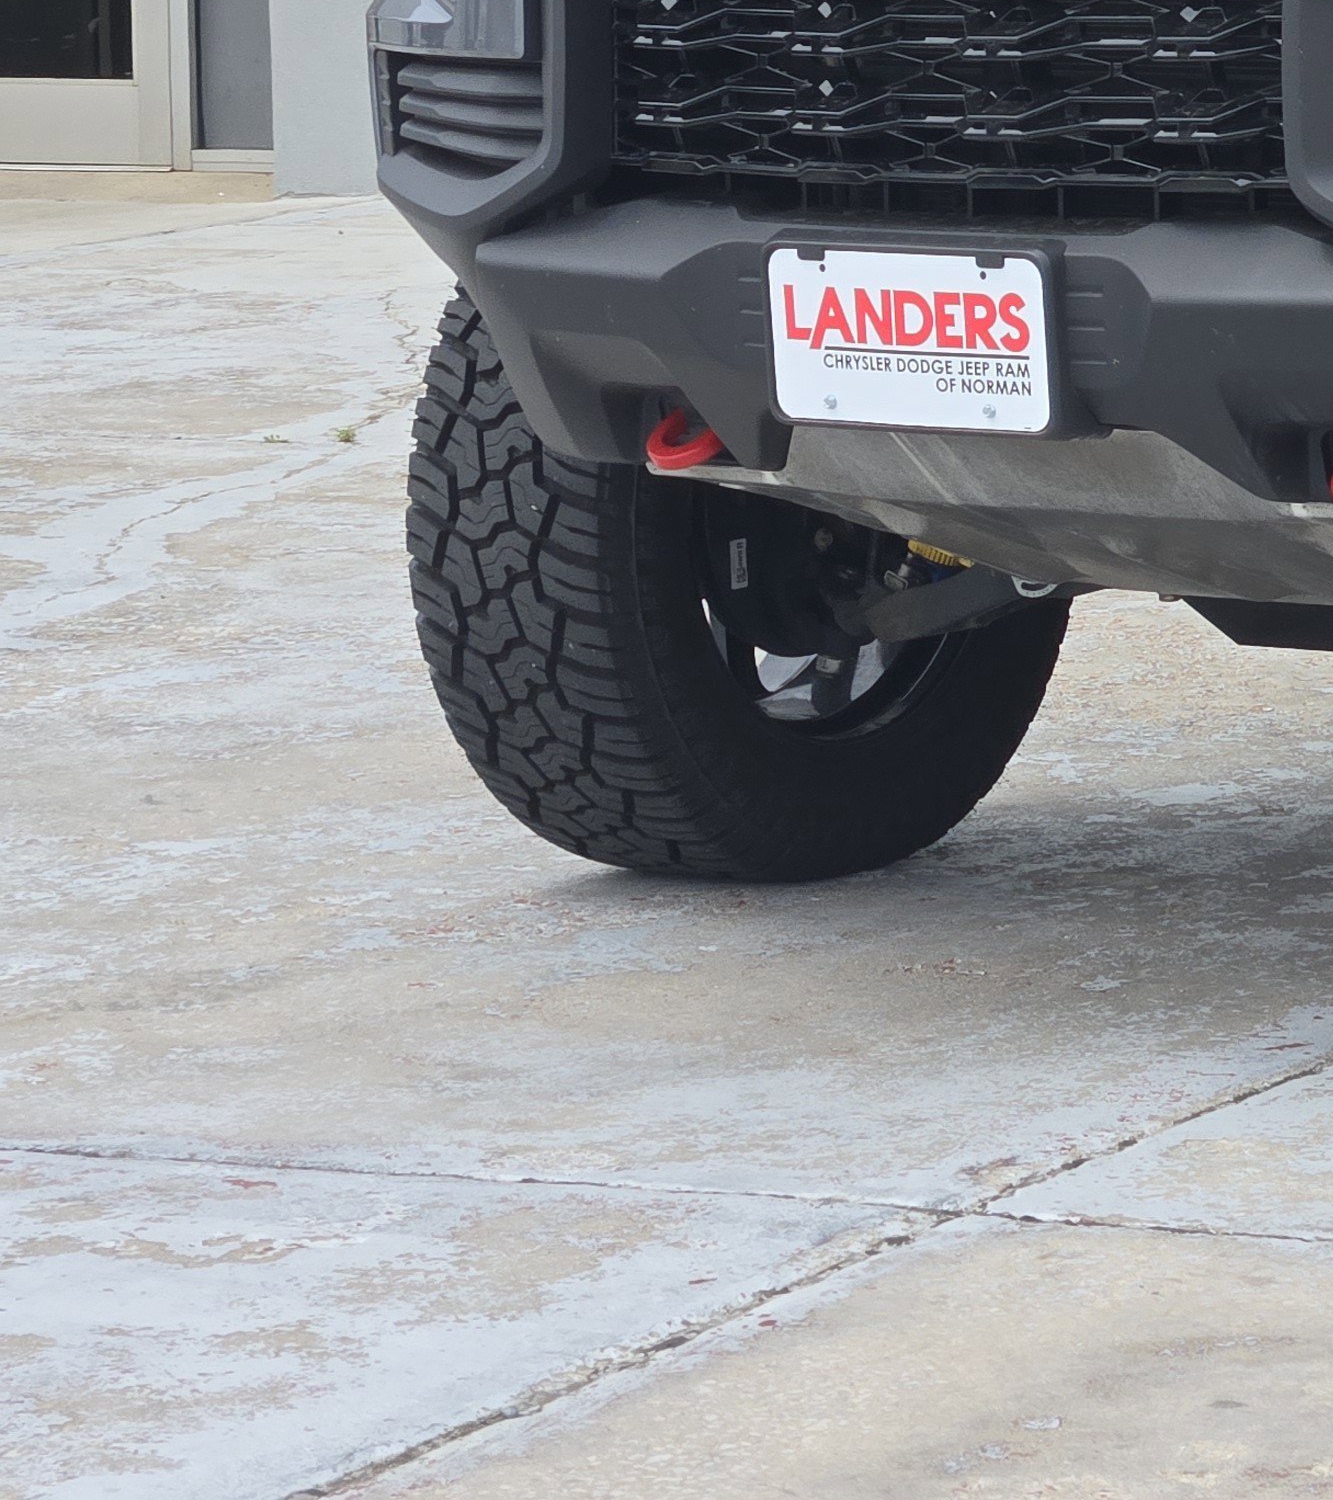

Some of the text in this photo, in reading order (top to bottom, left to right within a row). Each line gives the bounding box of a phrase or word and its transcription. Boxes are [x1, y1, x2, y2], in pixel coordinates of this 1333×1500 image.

[783, 284, 1030, 352] LANDERS
[823, 353, 1031, 378] CHRYSLER DODGE JEEP RAM
[936, 377, 1032, 396] OF NORMAN
